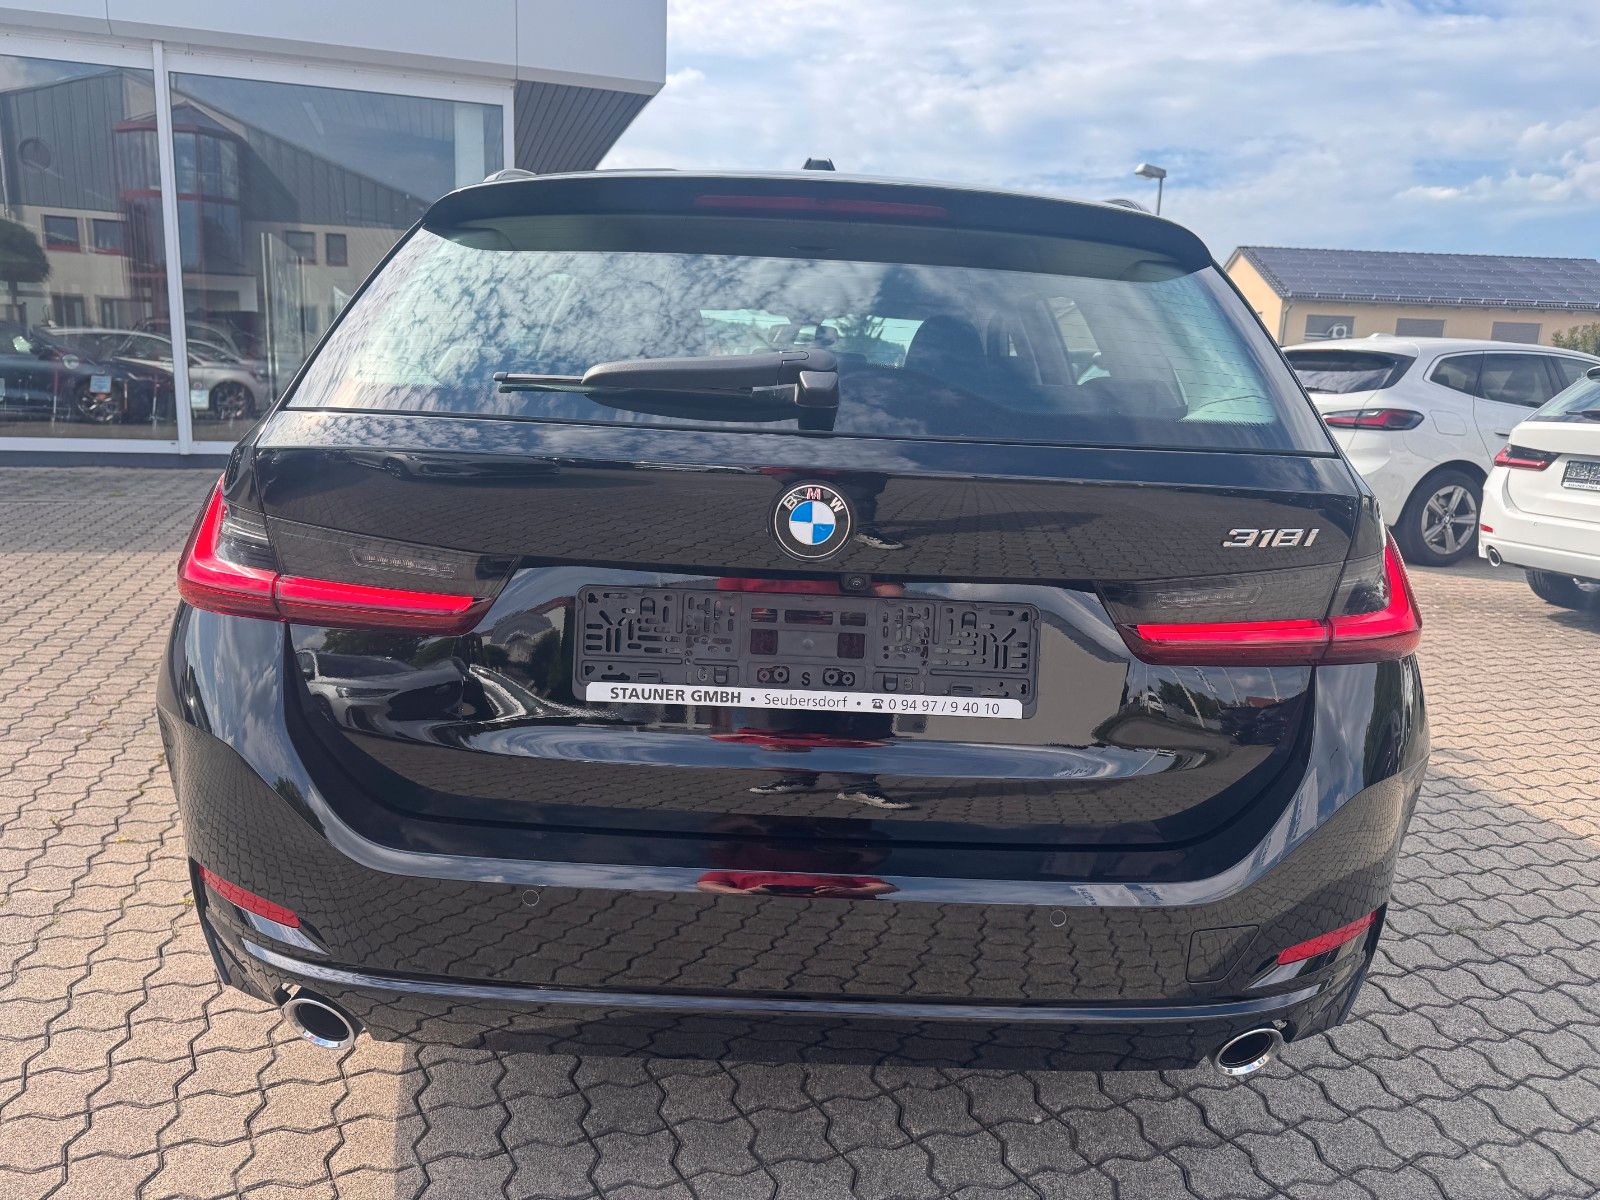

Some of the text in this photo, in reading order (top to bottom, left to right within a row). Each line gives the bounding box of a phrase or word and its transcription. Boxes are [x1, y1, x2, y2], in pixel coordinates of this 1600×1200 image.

[783, 488, 844, 512] BMW
[801, 671, 811, 686] S
[610, 686, 685, 702] STAUNER
[690, 689, 741, 704] GMBH
[764, 693, 847, 708] Seubersdorf
[888, 699, 897, 710] 0
[901, 699, 917, 711] 94
[922, 700, 937, 712] 97
[950, 701, 958, 713] 9
[962, 702, 979, 714] 40
[985, 703, 1000, 715] 10
